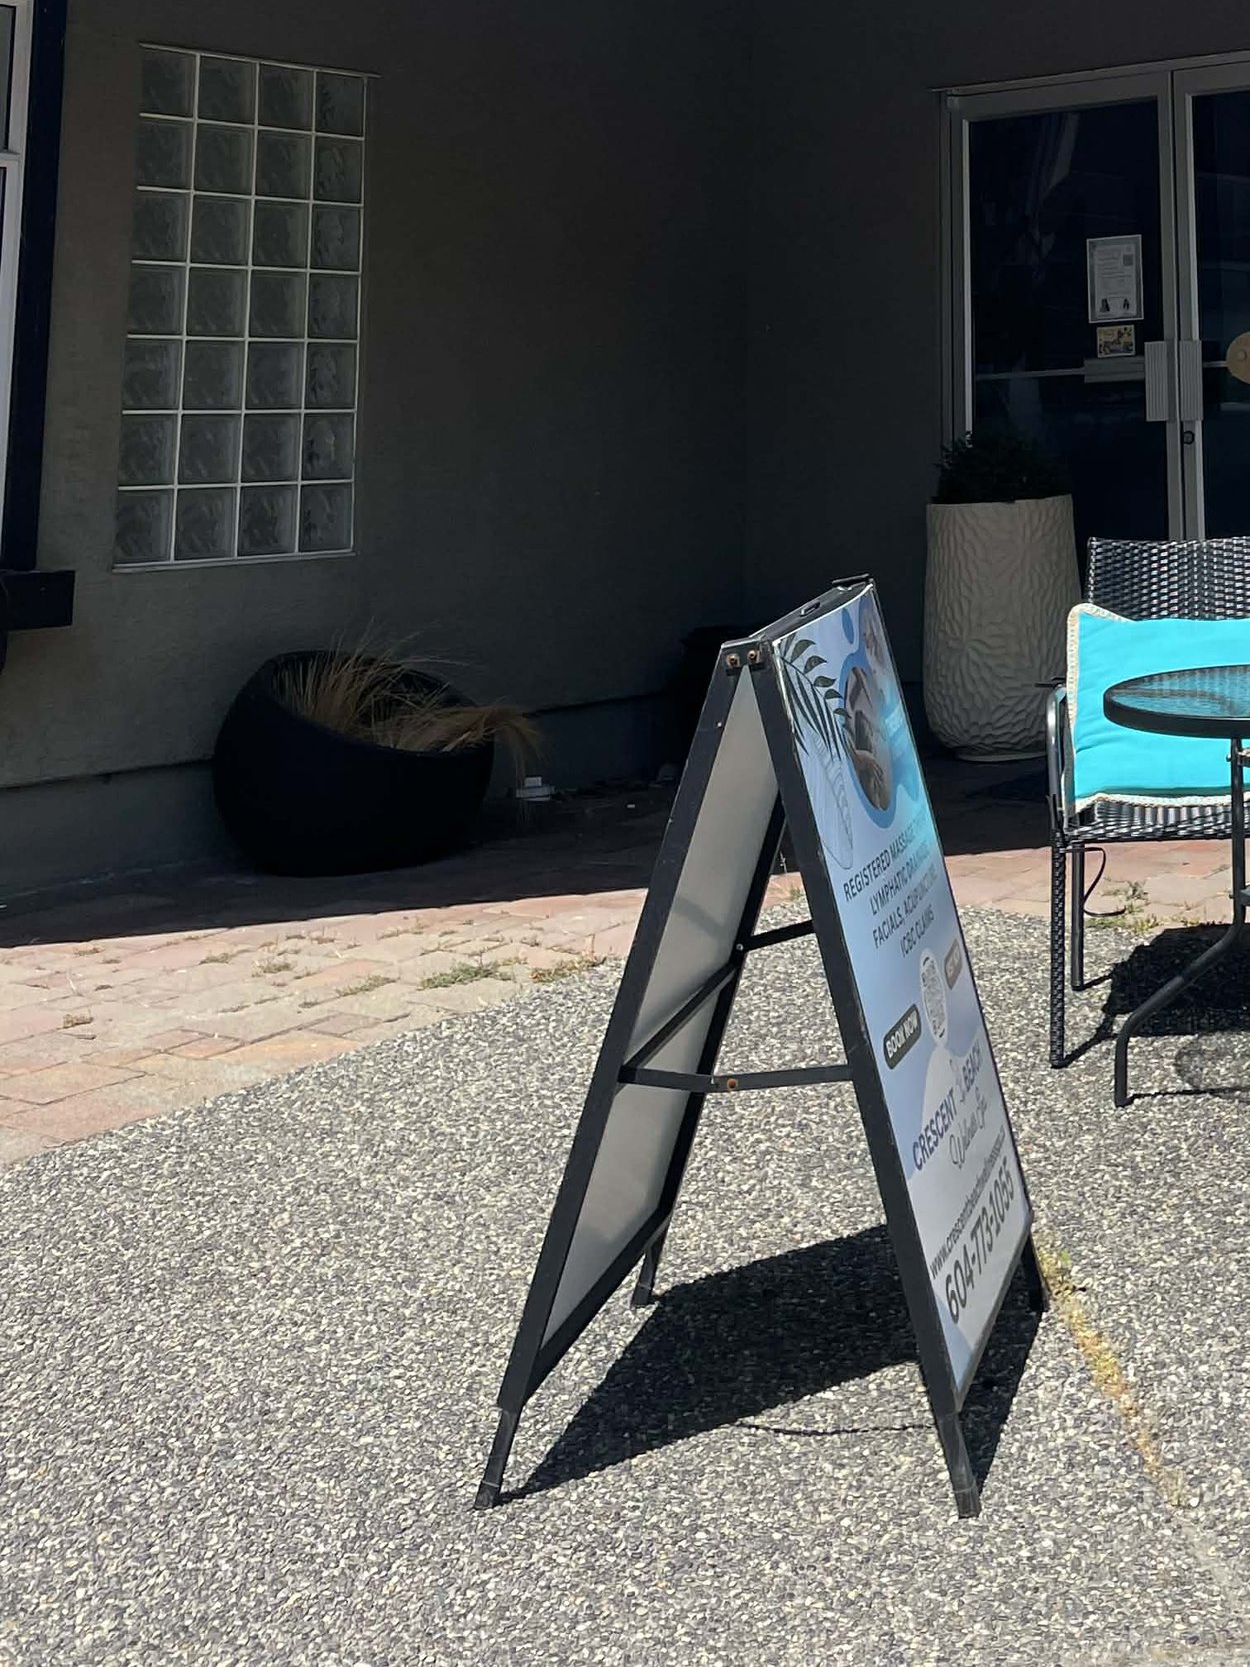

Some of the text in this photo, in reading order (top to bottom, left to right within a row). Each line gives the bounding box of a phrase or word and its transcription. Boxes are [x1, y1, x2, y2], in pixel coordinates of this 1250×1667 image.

[843, 849, 891, 903] REGISTERED
[869, 866, 908, 916] LYMPHATIC
[885, 1010, 919, 1059] BOOK NOW
[912, 1040, 983, 1171] CRESCENT BEACH
[945, 1156, 1014, 1325] 604-773-1055
